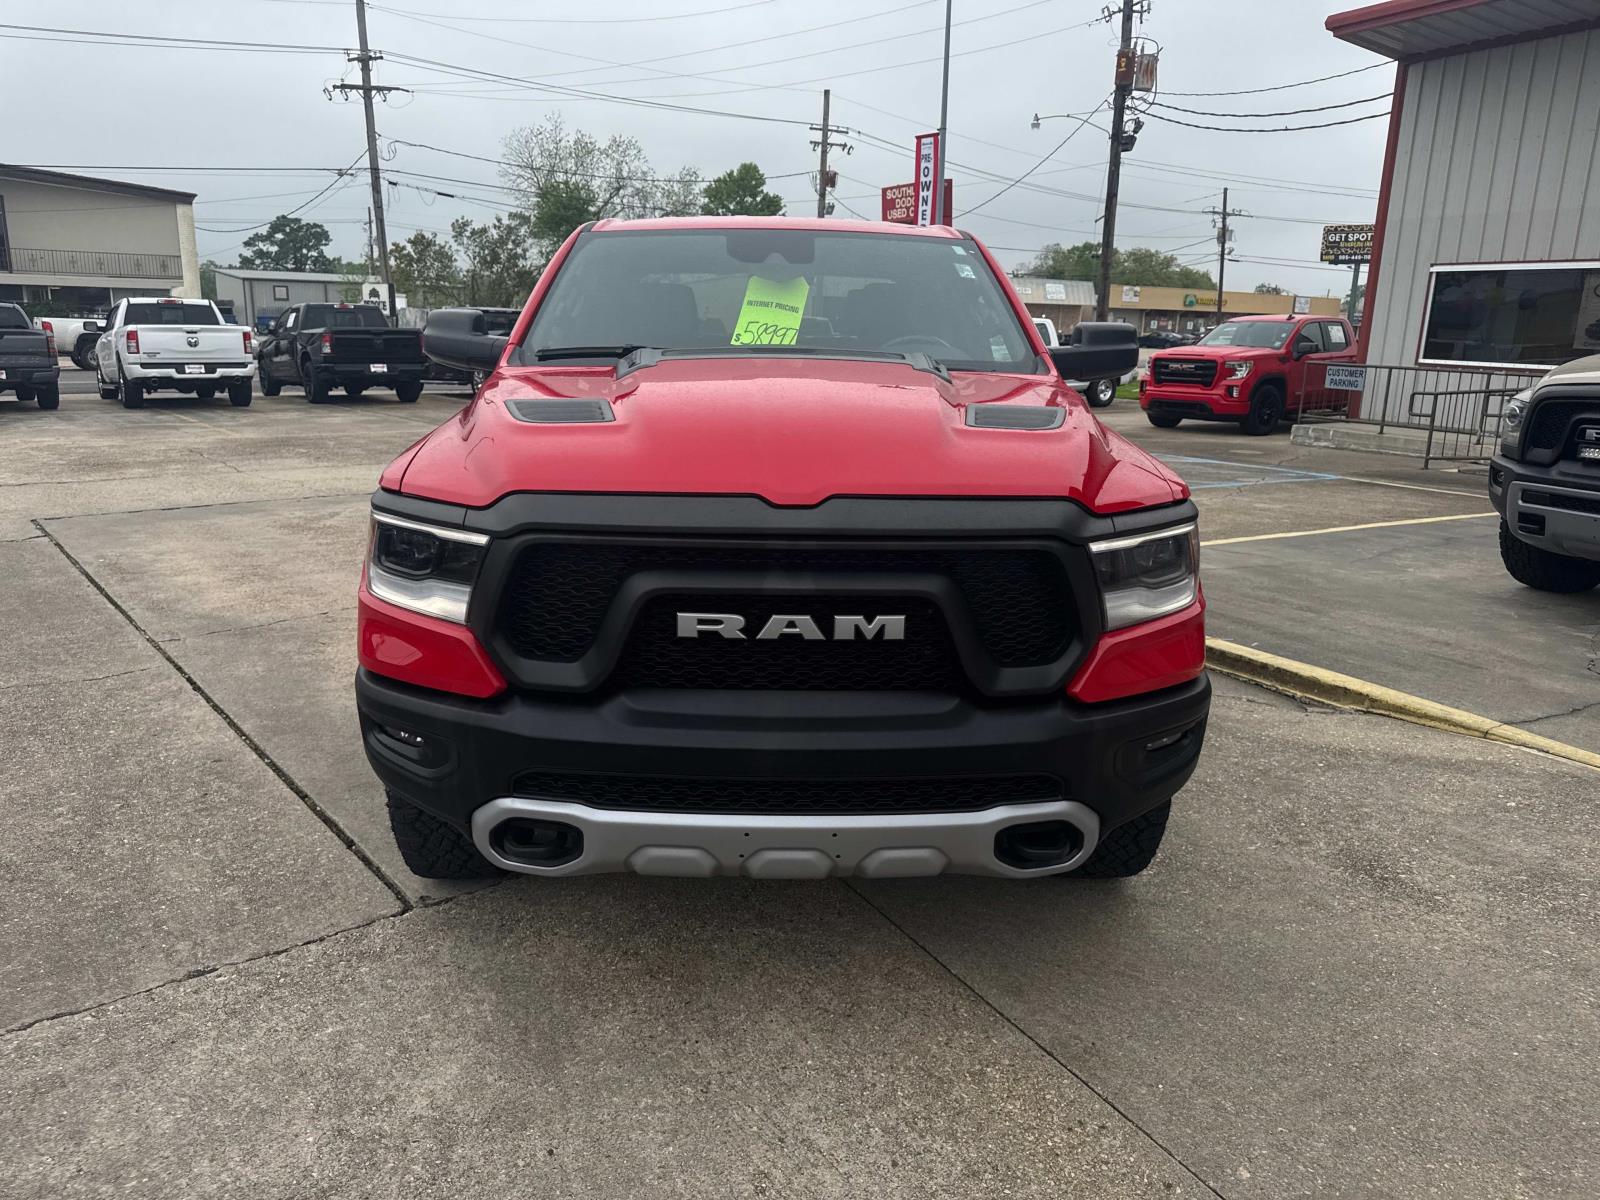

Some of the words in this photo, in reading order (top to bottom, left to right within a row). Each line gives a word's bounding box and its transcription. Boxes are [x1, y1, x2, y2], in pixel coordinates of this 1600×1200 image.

[921, 153, 932, 163] PRE-
[887, 207, 907, 220] USED
[1329, 233, 1347, 242] GET
[1348, 232, 1374, 242] SPOT
[747, 299, 774, 308] INTERNET
[774, 302, 800, 313] PRICING
[1327, 368, 1364, 378] CUSTOMER
[1329, 378, 1359, 388] PARKING
[676, 612, 907, 640] RAM
